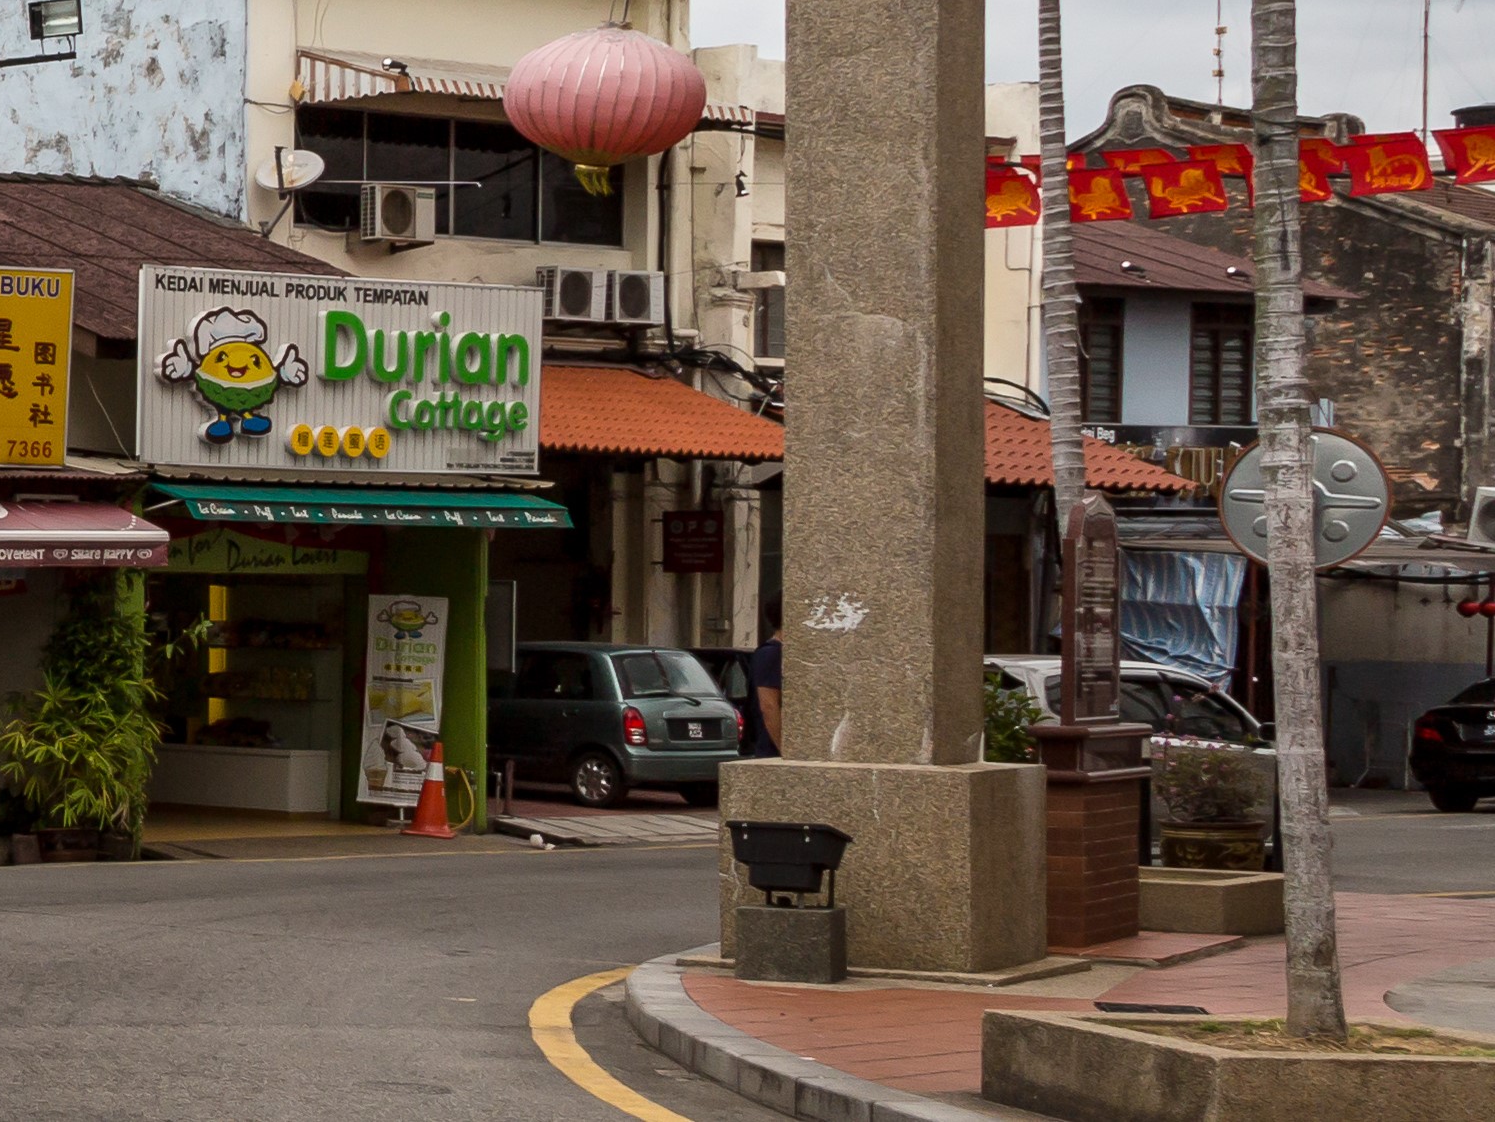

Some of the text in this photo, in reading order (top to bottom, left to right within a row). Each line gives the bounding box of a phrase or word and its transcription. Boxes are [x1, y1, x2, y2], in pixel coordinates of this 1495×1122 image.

[0, 275, 61, 298] BUKU
[155, 274, 429, 306] KEDAI MENJUAL PRODUK TEMPATAN
[320, 310, 530, 386] Durian
[390, 389, 528, 442] Cottage
[7, 440, 53, 459] 7366
